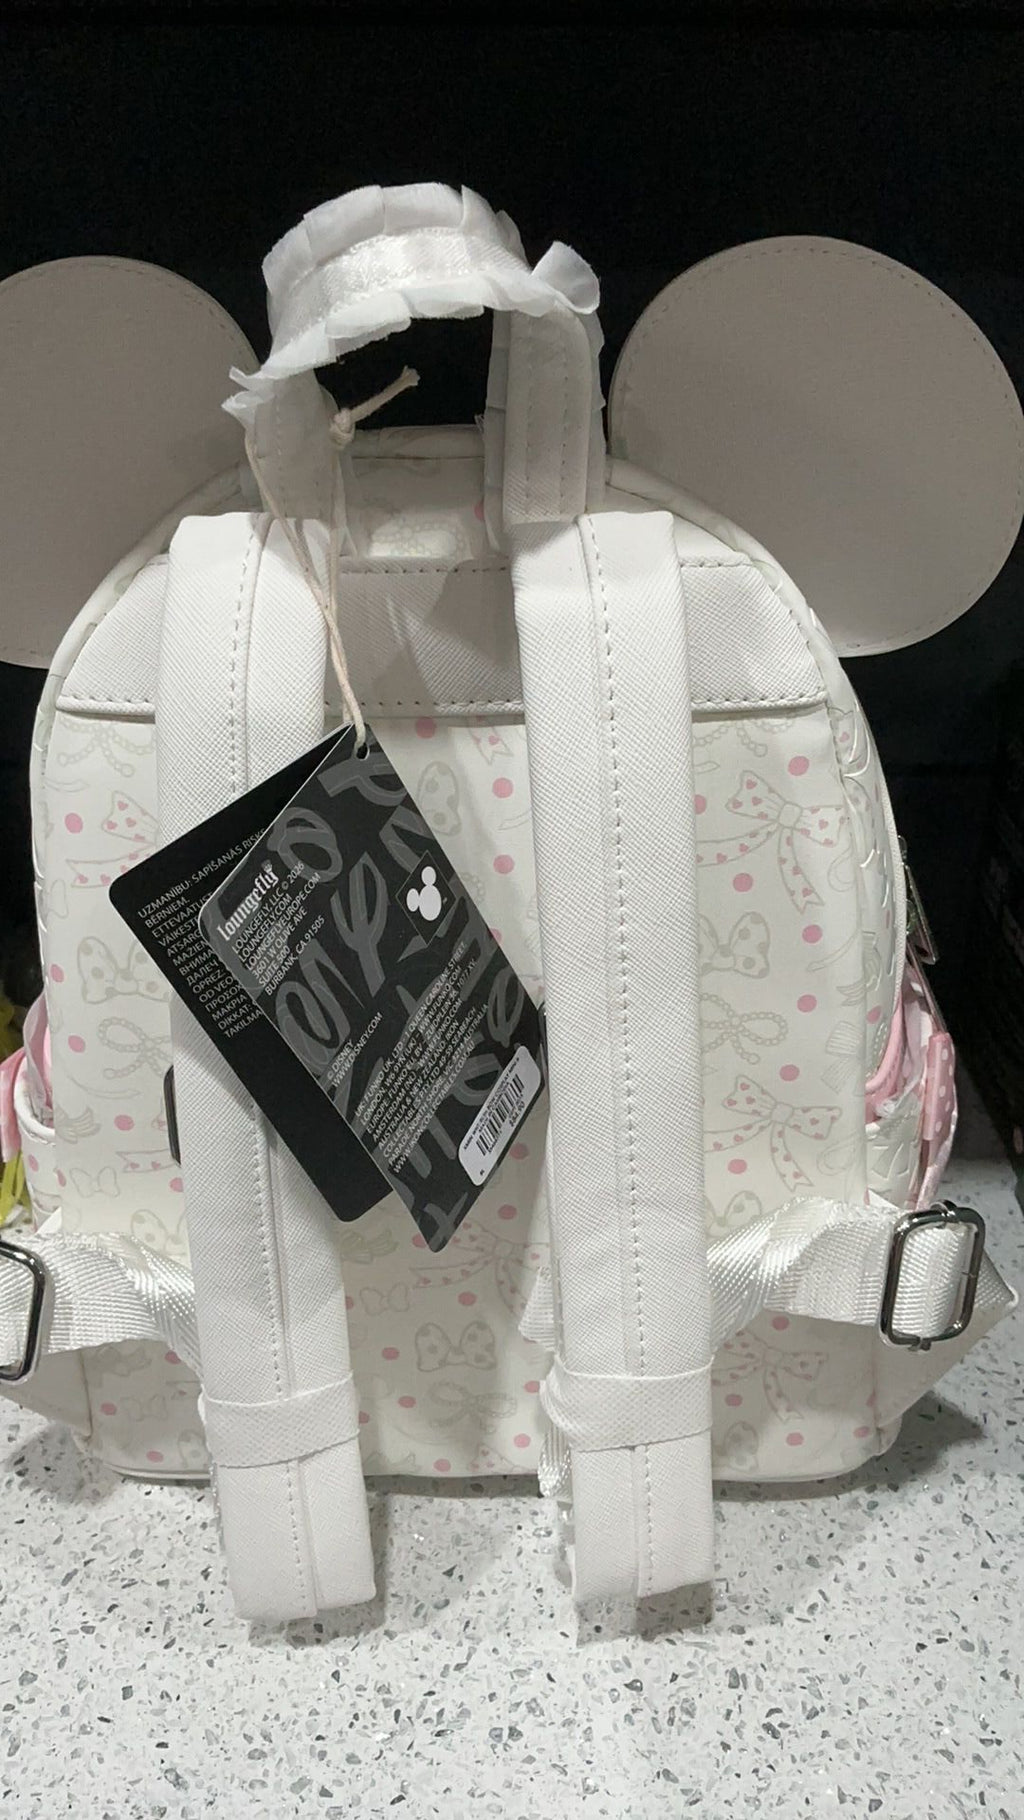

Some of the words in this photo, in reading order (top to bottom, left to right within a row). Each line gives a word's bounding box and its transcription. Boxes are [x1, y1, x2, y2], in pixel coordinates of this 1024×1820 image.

[216, 867, 280, 941] loungefly
[238, 891, 292, 963] LOUNGEFLY.COM
[245, 870, 320, 971] LOUNGEFLYEUROPE.COM
[269, 886, 283, 906] LLC
[252, 954, 270, 979] 3601
[267, 944, 277, 959] W
[274, 920, 295, 950] OLIVE
[292, 904, 307, 926] AVE
[258, 959, 278, 988] SUITE
[276, 943, 290, 964] 500
[294, 936, 307, 955] CA
[304, 913, 325, 943] 91505
[198, 988, 215, 1003] OD
[331, 1011, 382, 1089] WWW.DISNEY.COM
[331, 1037, 355, 1073] DISNEY
[363, 1069, 385, 1103] FUNKO
[391, 1039, 404, 1059] LTD
[407, 1002, 427, 1034] QUEEN
[371, 1086, 406, 1142] AMSTERDAM
[377, 1102, 407, 1150] AUSTRALIA
[409, 1075, 423, 1099] NEW
[387, 1066, 408, 1099] FUNKO
